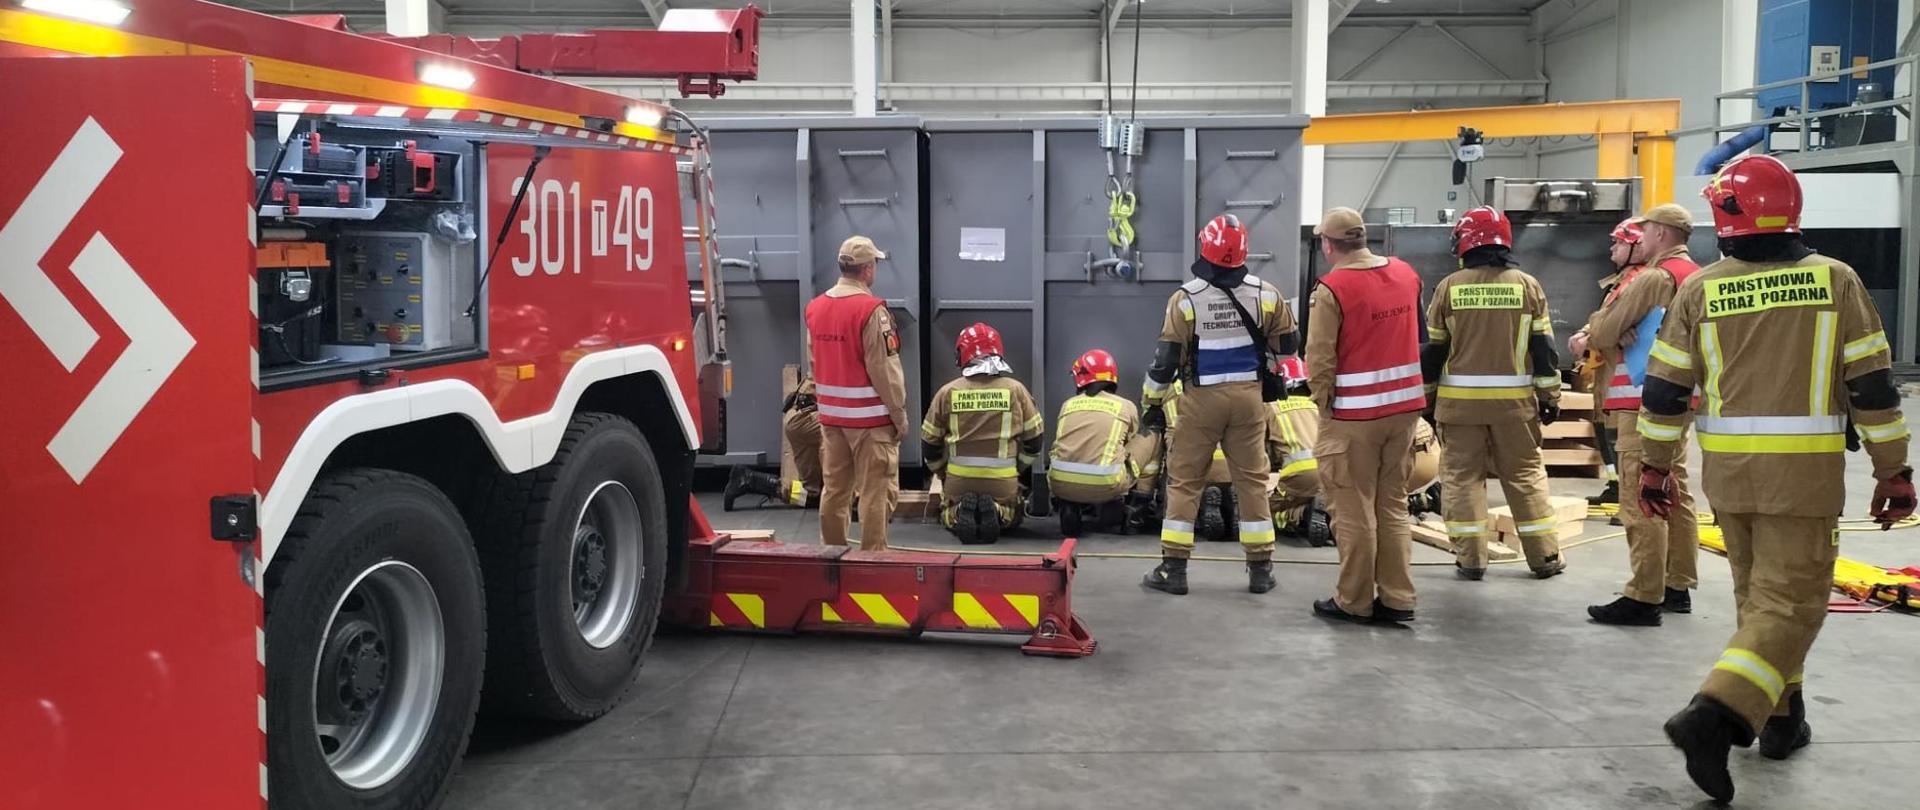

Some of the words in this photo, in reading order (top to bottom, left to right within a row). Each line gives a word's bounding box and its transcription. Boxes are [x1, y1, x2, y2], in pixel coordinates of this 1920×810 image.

[511, 176, 581, 277] 301
[613, 185, 654, 272] 49
[1718, 272, 1816, 296] PAŃSTWOWA
[1214, 311, 1237, 321] GRUPY
